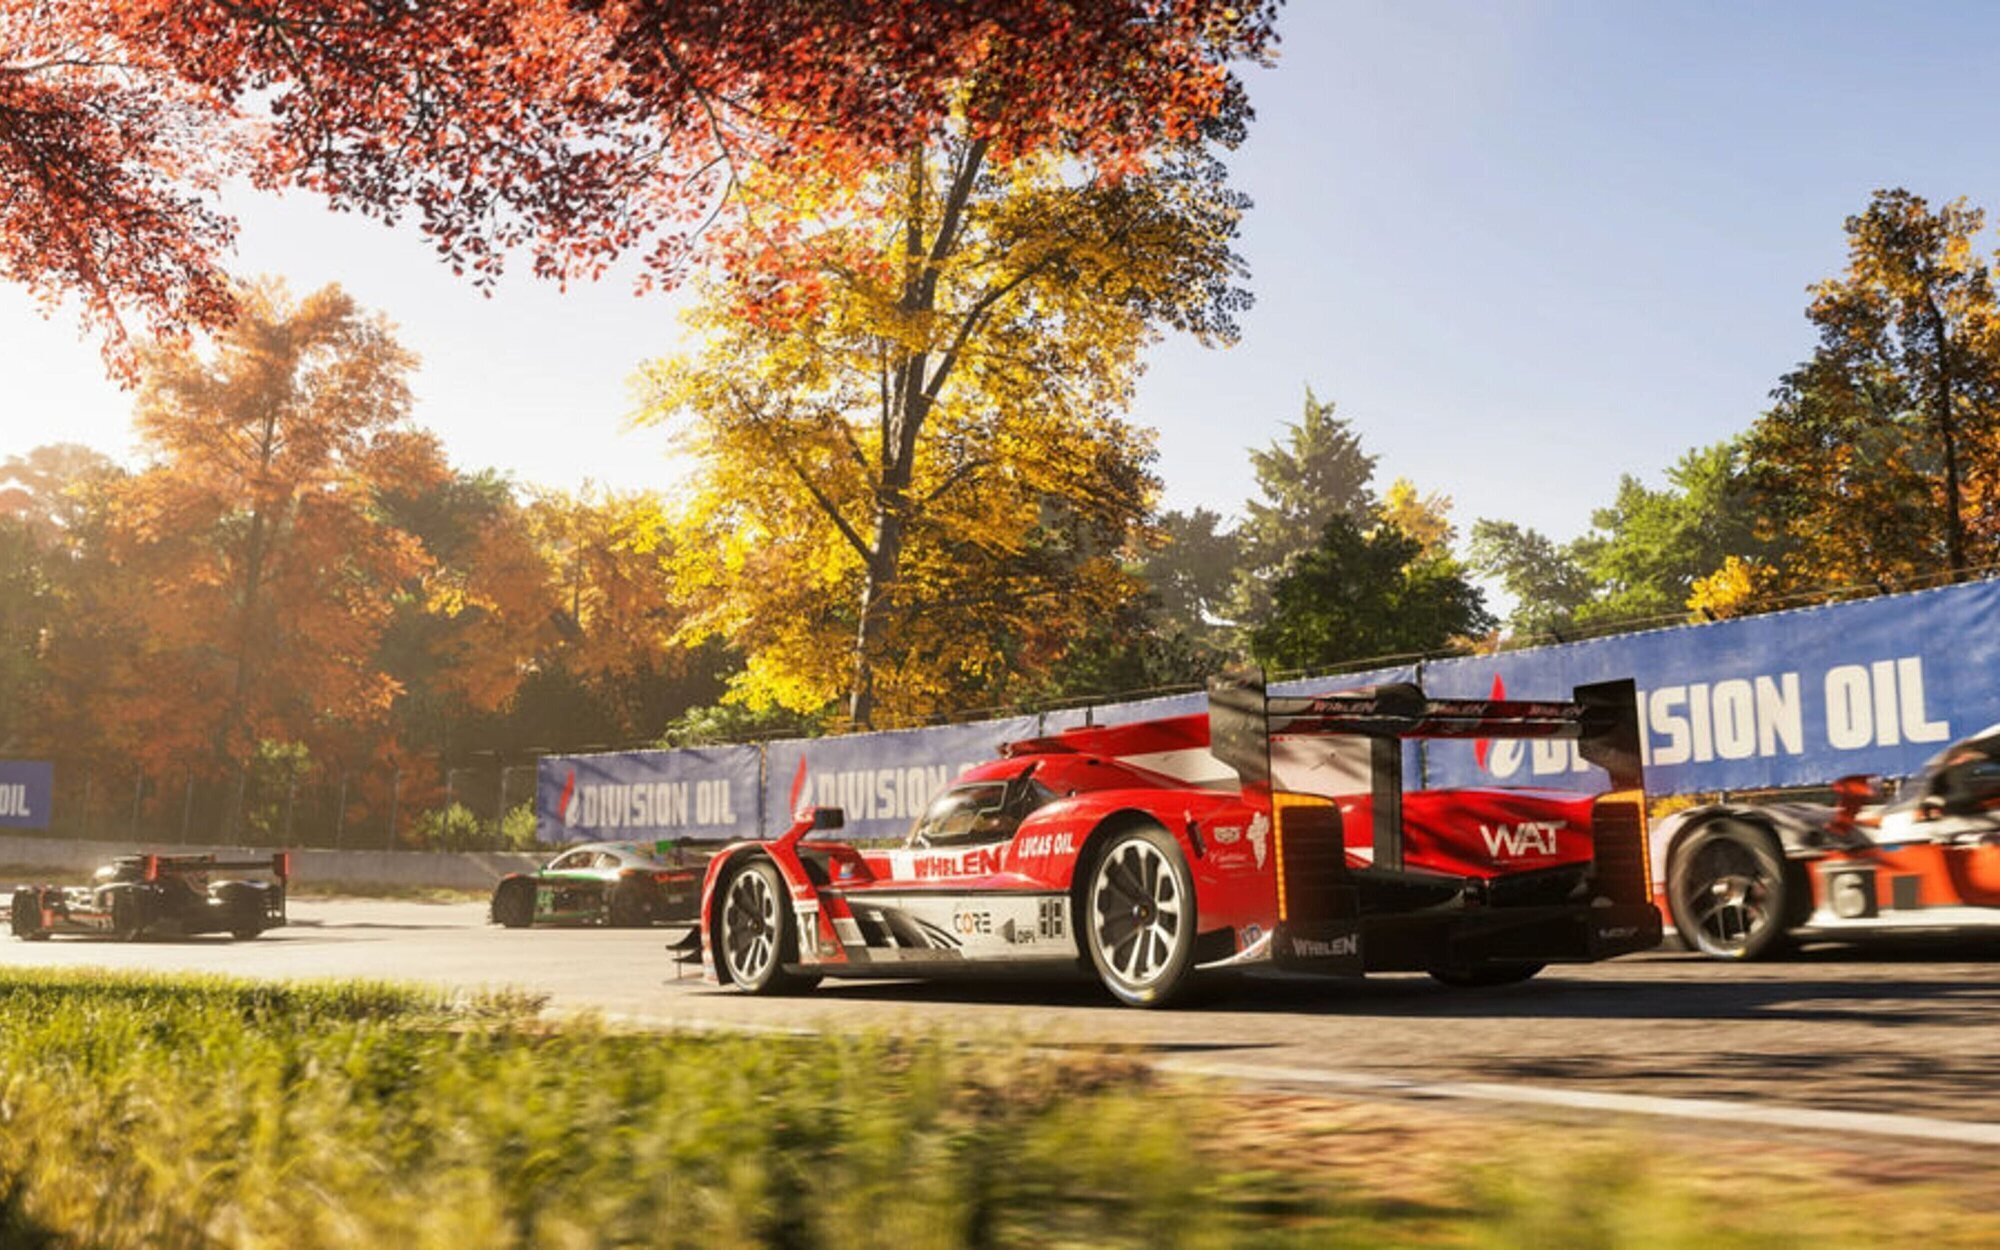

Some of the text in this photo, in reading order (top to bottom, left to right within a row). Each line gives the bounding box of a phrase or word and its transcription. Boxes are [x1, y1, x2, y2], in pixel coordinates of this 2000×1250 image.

[1824, 656, 1949, 750] OIL
[0, 784, 31, 817] OIL
[583, 779, 737, 827] DIVISION OIL
[1480, 820, 1567, 857] WAT
[913, 848, 1001, 879] WHELEN
[1832, 873, 1867, 918] 6
[954, 912, 991, 935] CORE
